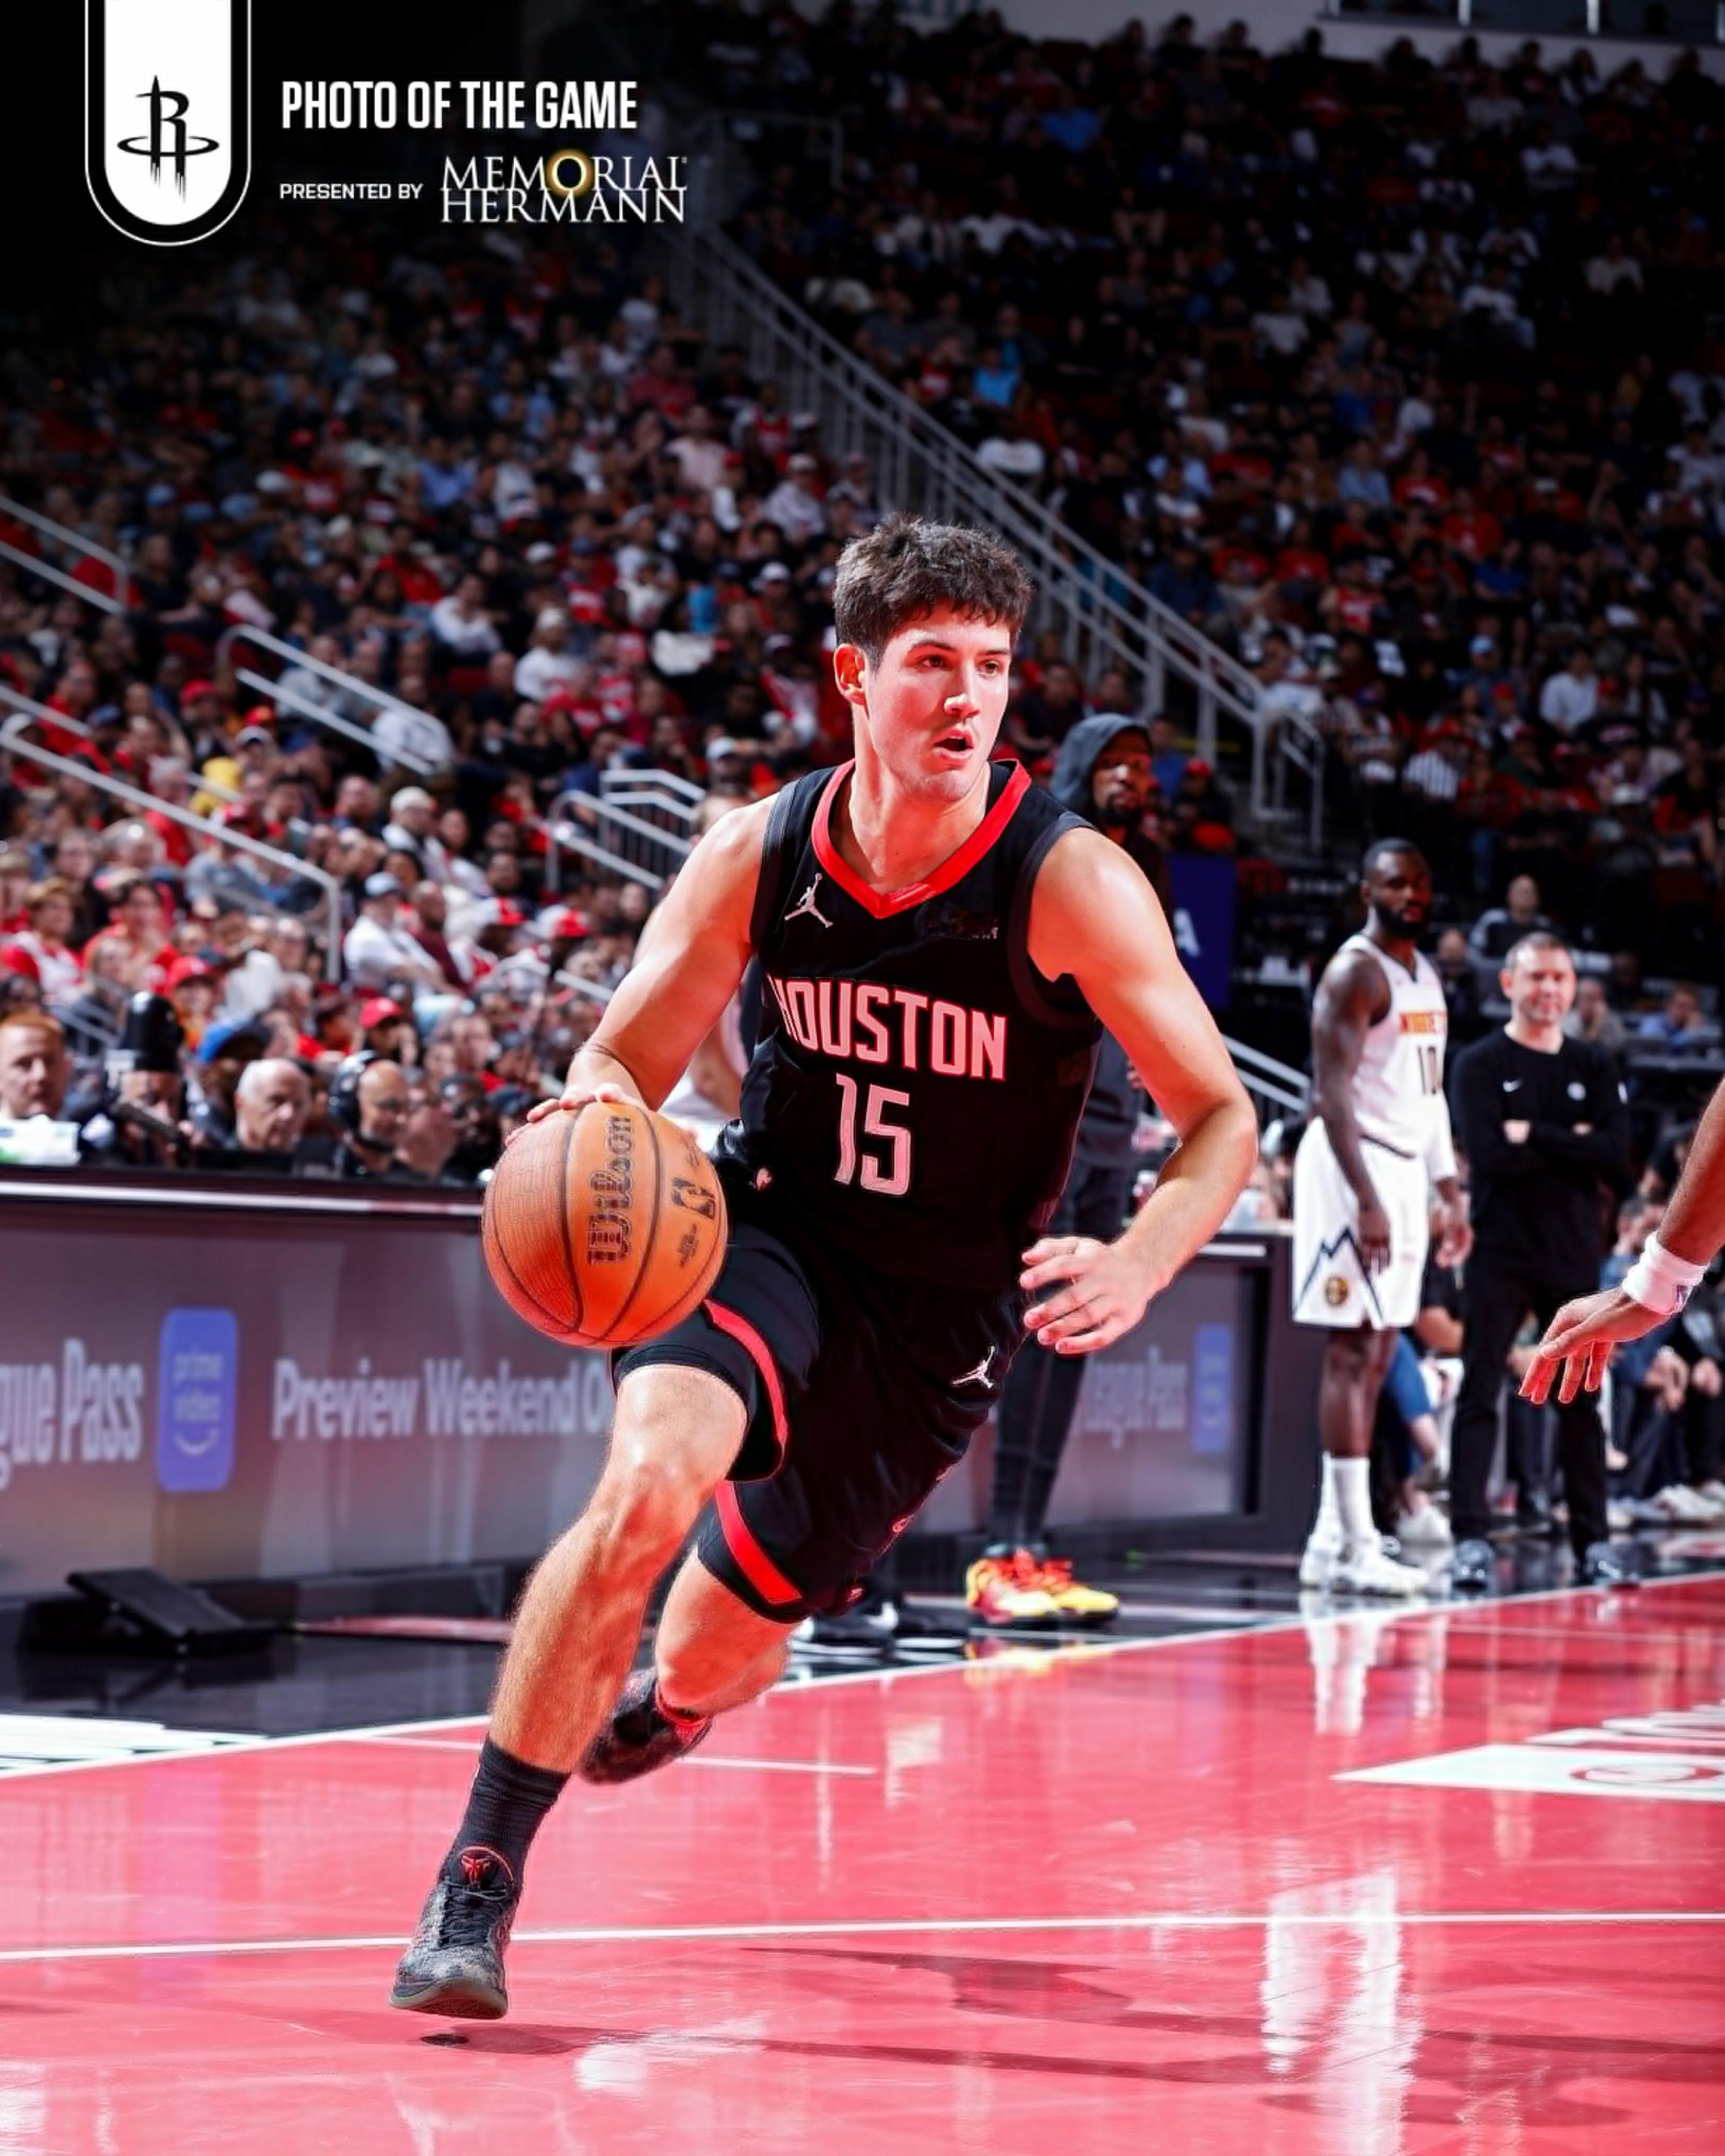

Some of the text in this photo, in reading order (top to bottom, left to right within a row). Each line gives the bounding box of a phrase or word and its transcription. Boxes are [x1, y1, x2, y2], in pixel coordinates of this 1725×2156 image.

[588, 1115, 632, 1265] Wilson
[833, 1072, 912, 1196] 15
[58, 1337, 143, 1462] Pass
[272, 1355, 611, 1439] Preview Weekend O
